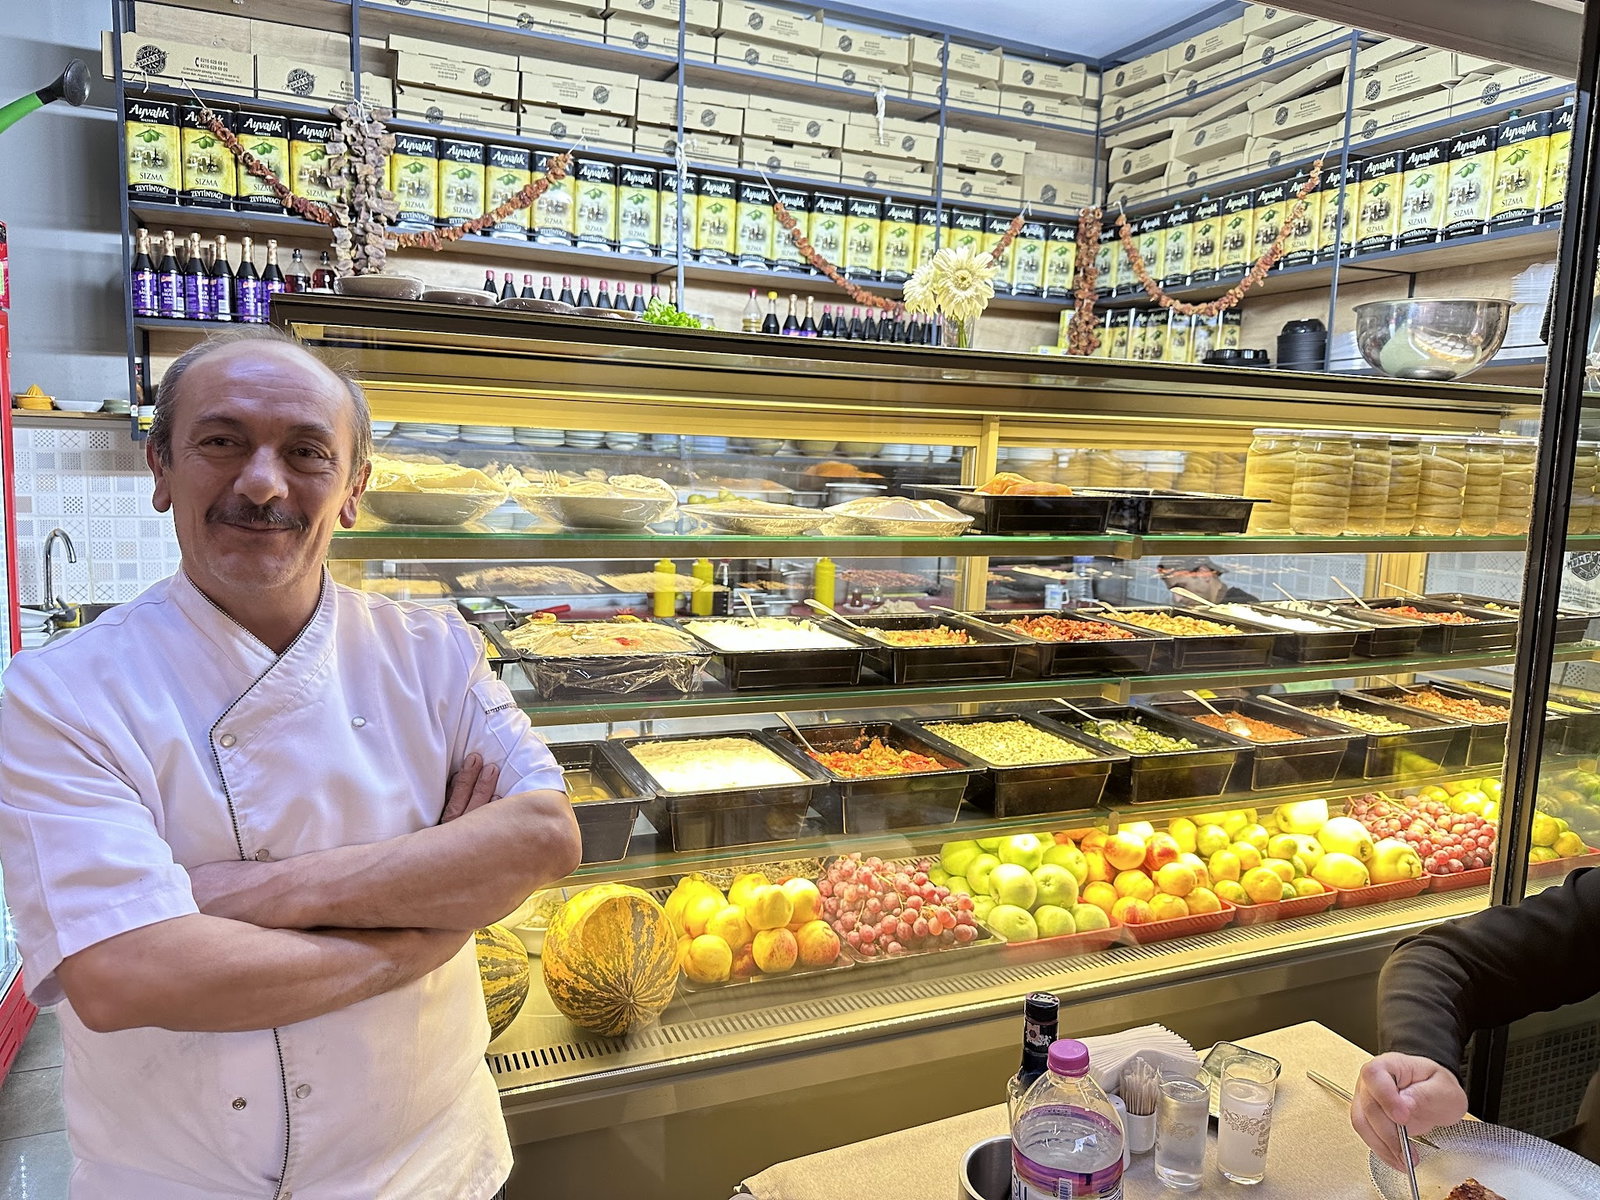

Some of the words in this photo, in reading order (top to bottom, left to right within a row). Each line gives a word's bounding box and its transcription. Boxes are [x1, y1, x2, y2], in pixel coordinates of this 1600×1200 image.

[129, 104, 169, 119] Ayvalık
[244, 117, 282, 132] Ayvalık
[297, 124, 332, 139] Ayvalı
[1500, 120, 1538, 140] Ayvalık
[398, 138, 432, 153] Ayvalık
[1451, 134, 1488, 154] Ayvalık
[446, 145, 481, 159] Ayvalık
[492, 151, 525, 165] Ayvalık
[1406, 147, 1440, 166] Ayvalık
[579, 165, 611, 180] Ayvalık
[1365, 157, 1396, 176] Ayvalık
[140, 172, 164, 181] SIZMA
[195, 178, 218, 187] SIZMA
[623, 171, 653, 185] Ayvalık
[306, 189, 328, 198] SIZMA
[405, 201, 425, 210] SIZMA
[1501, 197, 1524, 208] SIZMA
[453, 206, 473, 215] SIZMA
[1454, 208, 1474, 218] SIZMA
[1408, 217, 1428, 225] SIZMA
